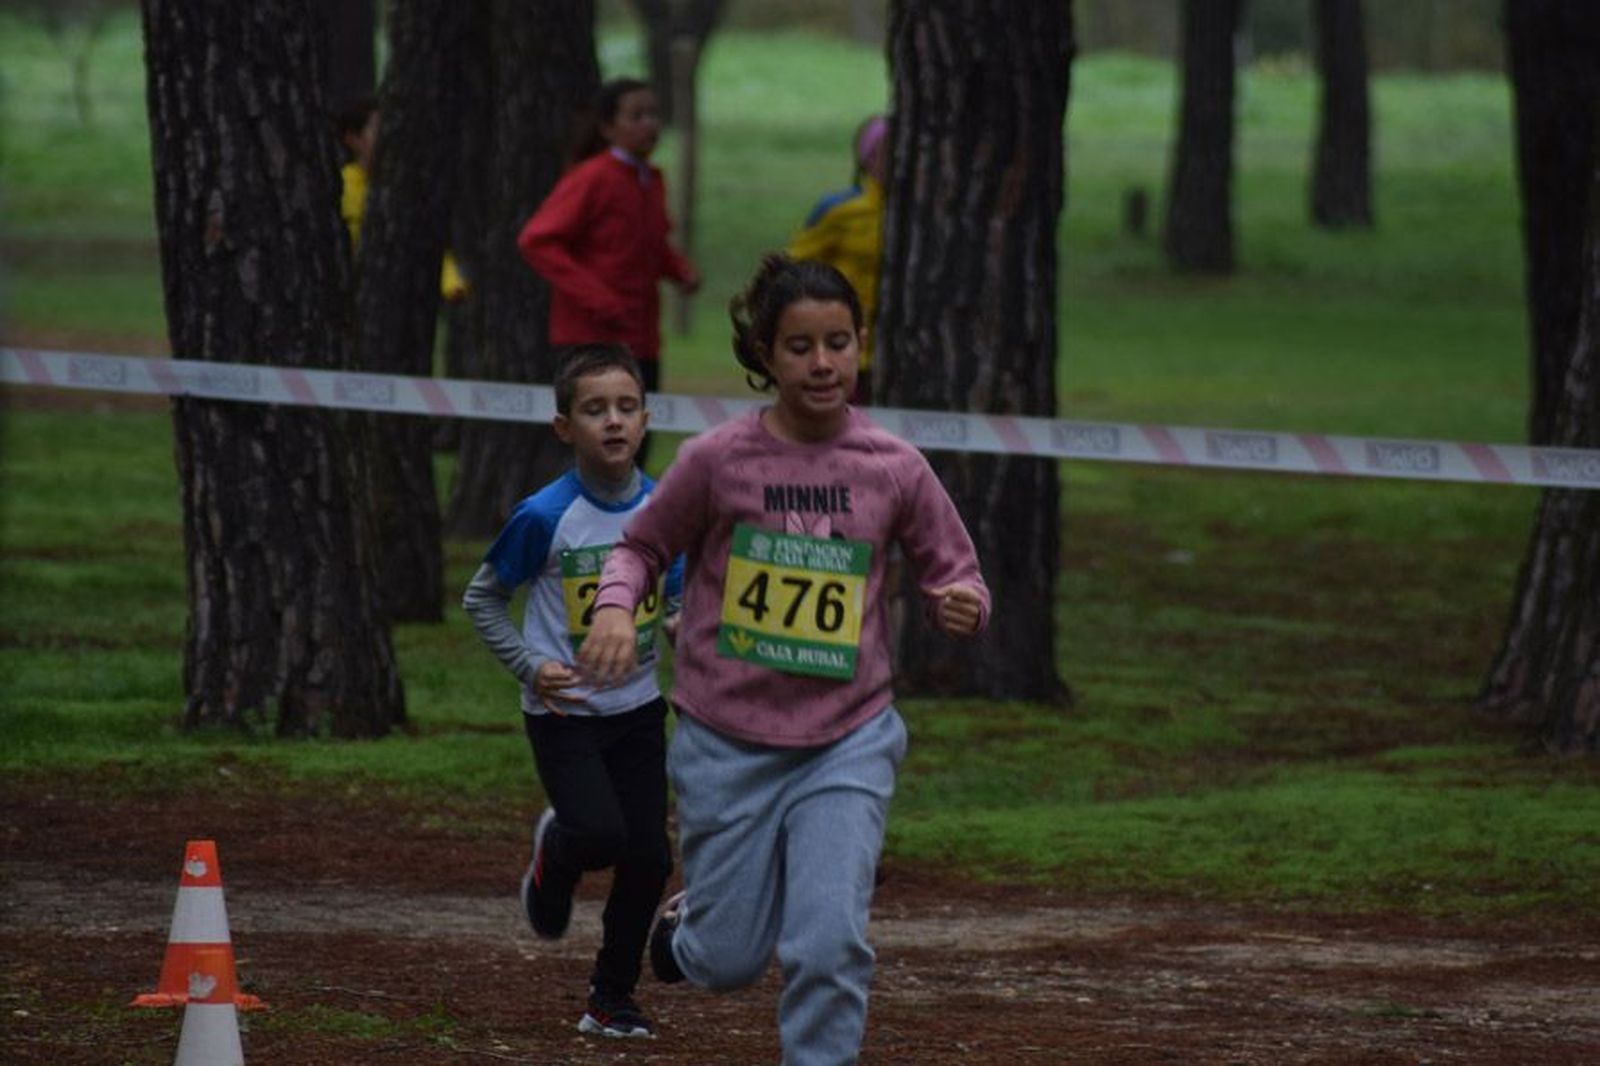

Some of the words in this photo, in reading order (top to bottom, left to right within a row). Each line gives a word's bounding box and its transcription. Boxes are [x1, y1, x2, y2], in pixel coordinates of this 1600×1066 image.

[764, 485, 853, 513] MINNIE
[807, 555, 850, 572] RURAL
[738, 571, 846, 632] 476
[756, 641, 794, 662] CAJA
[797, 647, 848, 669] RURAL
